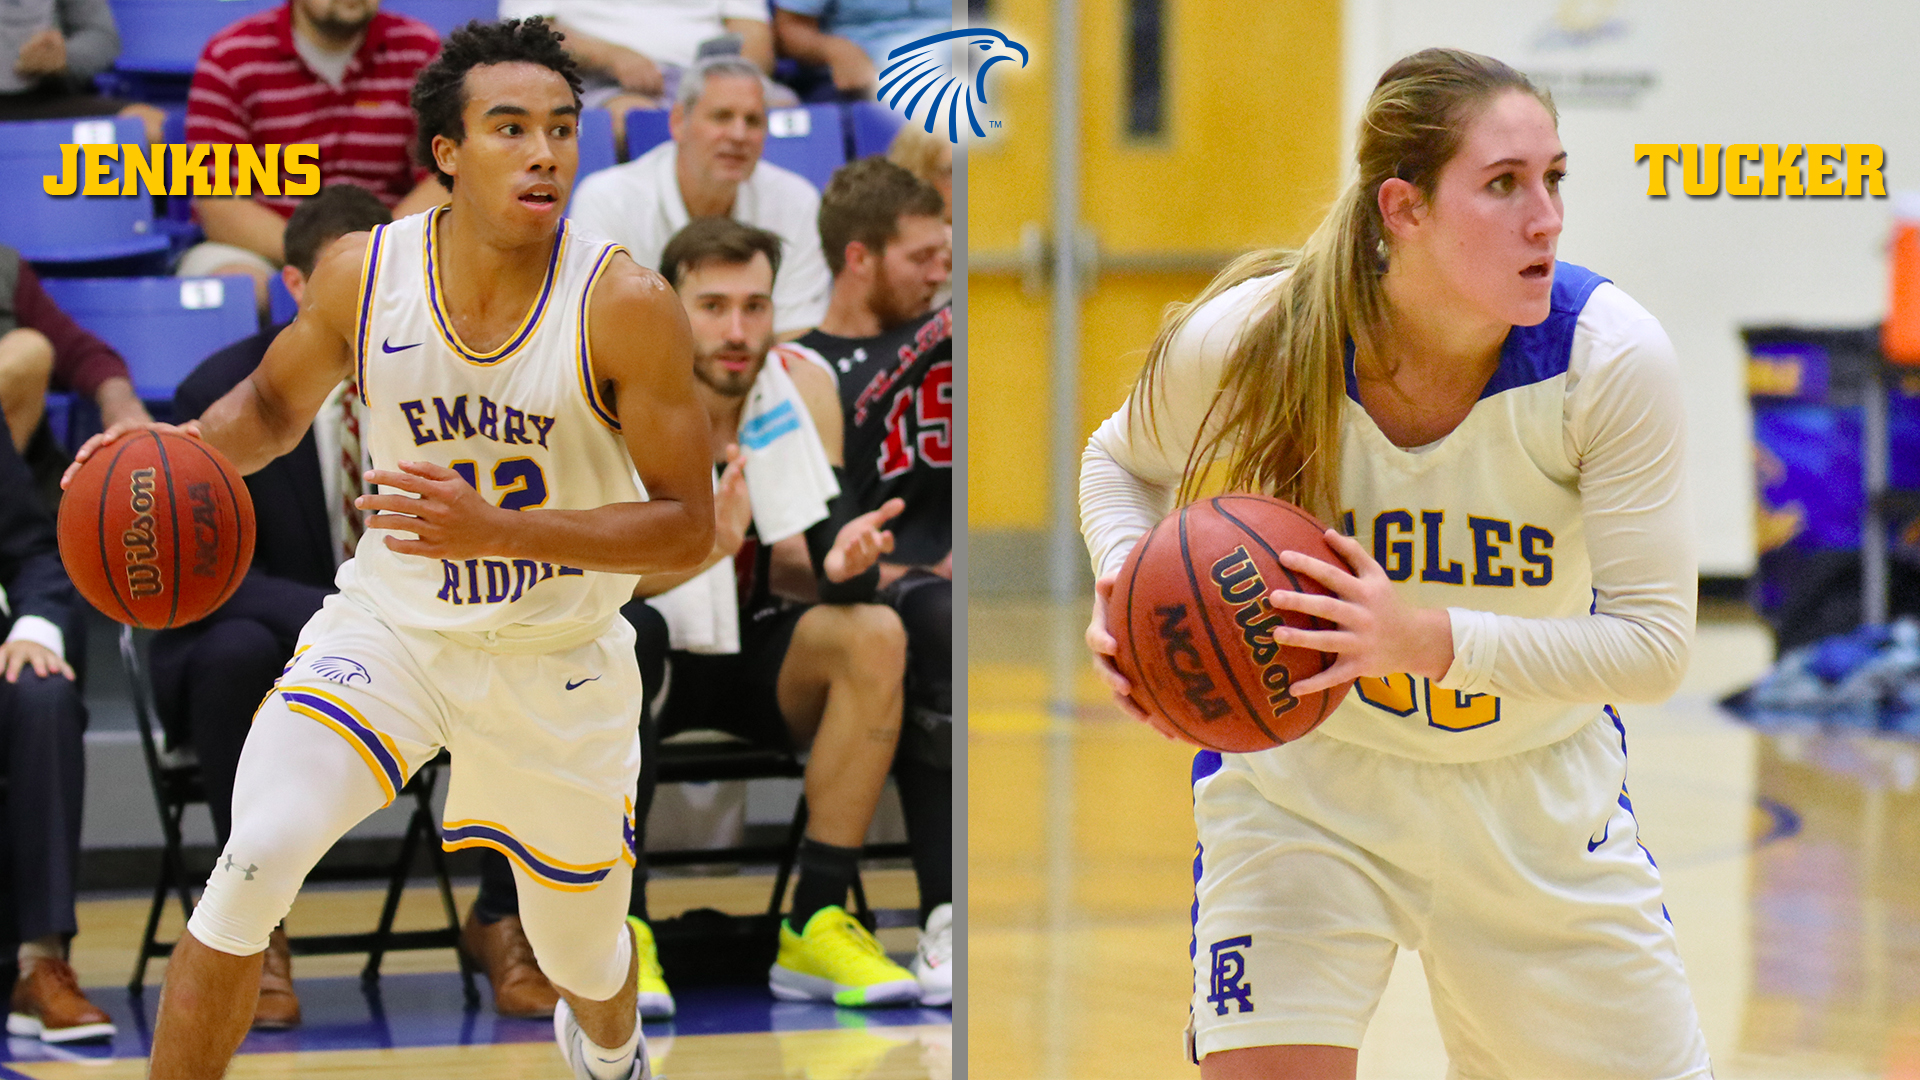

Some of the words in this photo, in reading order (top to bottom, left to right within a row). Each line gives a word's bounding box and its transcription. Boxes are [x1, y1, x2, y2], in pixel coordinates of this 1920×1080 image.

[399, 394, 556, 451] EMBRY
[877, 360, 953, 481] 15
[122, 466, 164, 600] Wilson
[187, 481, 220, 579] NCAA
[1343, 507, 1556, 589] GLES
[1154, 603, 1233, 723] NCAA
[1210, 544, 1301, 719] Wilson
